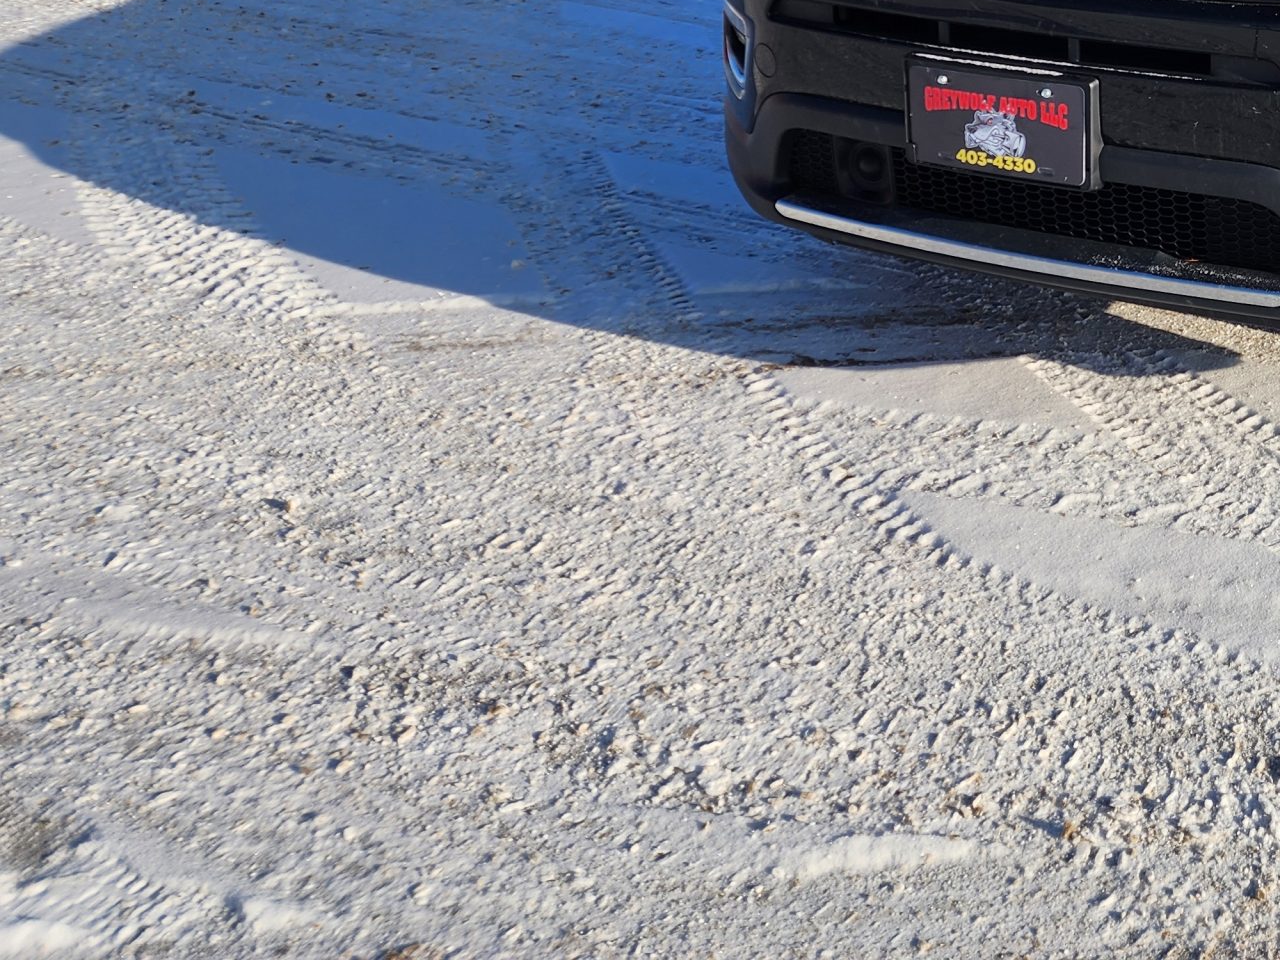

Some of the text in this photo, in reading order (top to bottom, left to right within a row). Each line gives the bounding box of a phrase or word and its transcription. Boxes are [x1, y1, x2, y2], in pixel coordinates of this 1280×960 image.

[924, 86, 1069, 131] GREYWOLF AUTO LLC
[955, 148, 1037, 174] 403-4330
